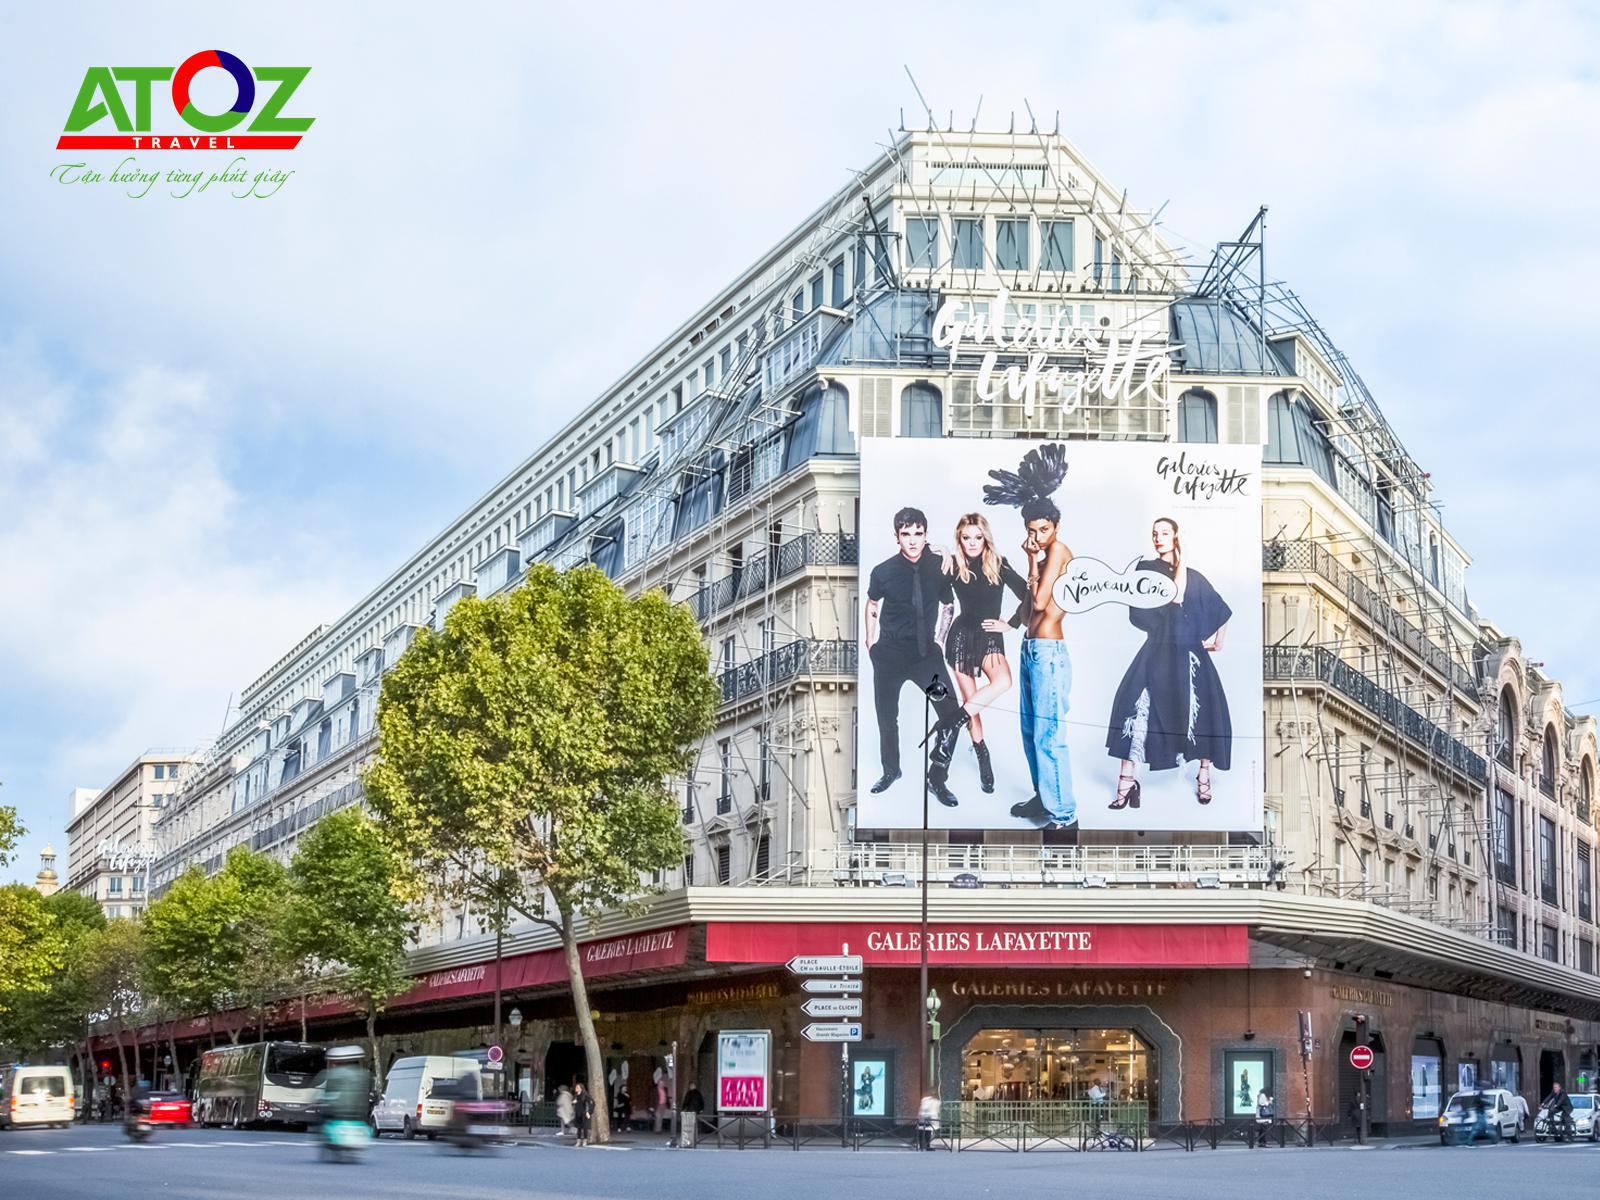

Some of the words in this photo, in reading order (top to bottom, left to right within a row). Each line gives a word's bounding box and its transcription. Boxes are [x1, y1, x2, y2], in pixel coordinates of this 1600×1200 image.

[932, 288, 1102, 364] Galeries
[976, 332, 1187, 417] Lafayette
[1156, 451, 1220, 480] Galeries
[1173, 468, 1252, 501] Lafayette
[866, 931, 970, 951] GALERIES
[975, 931, 1092, 951] LAFAYETTE
[952, 980, 1050, 996] GALERIES
[1056, 980, 1167, 996] LAFAYETTE
